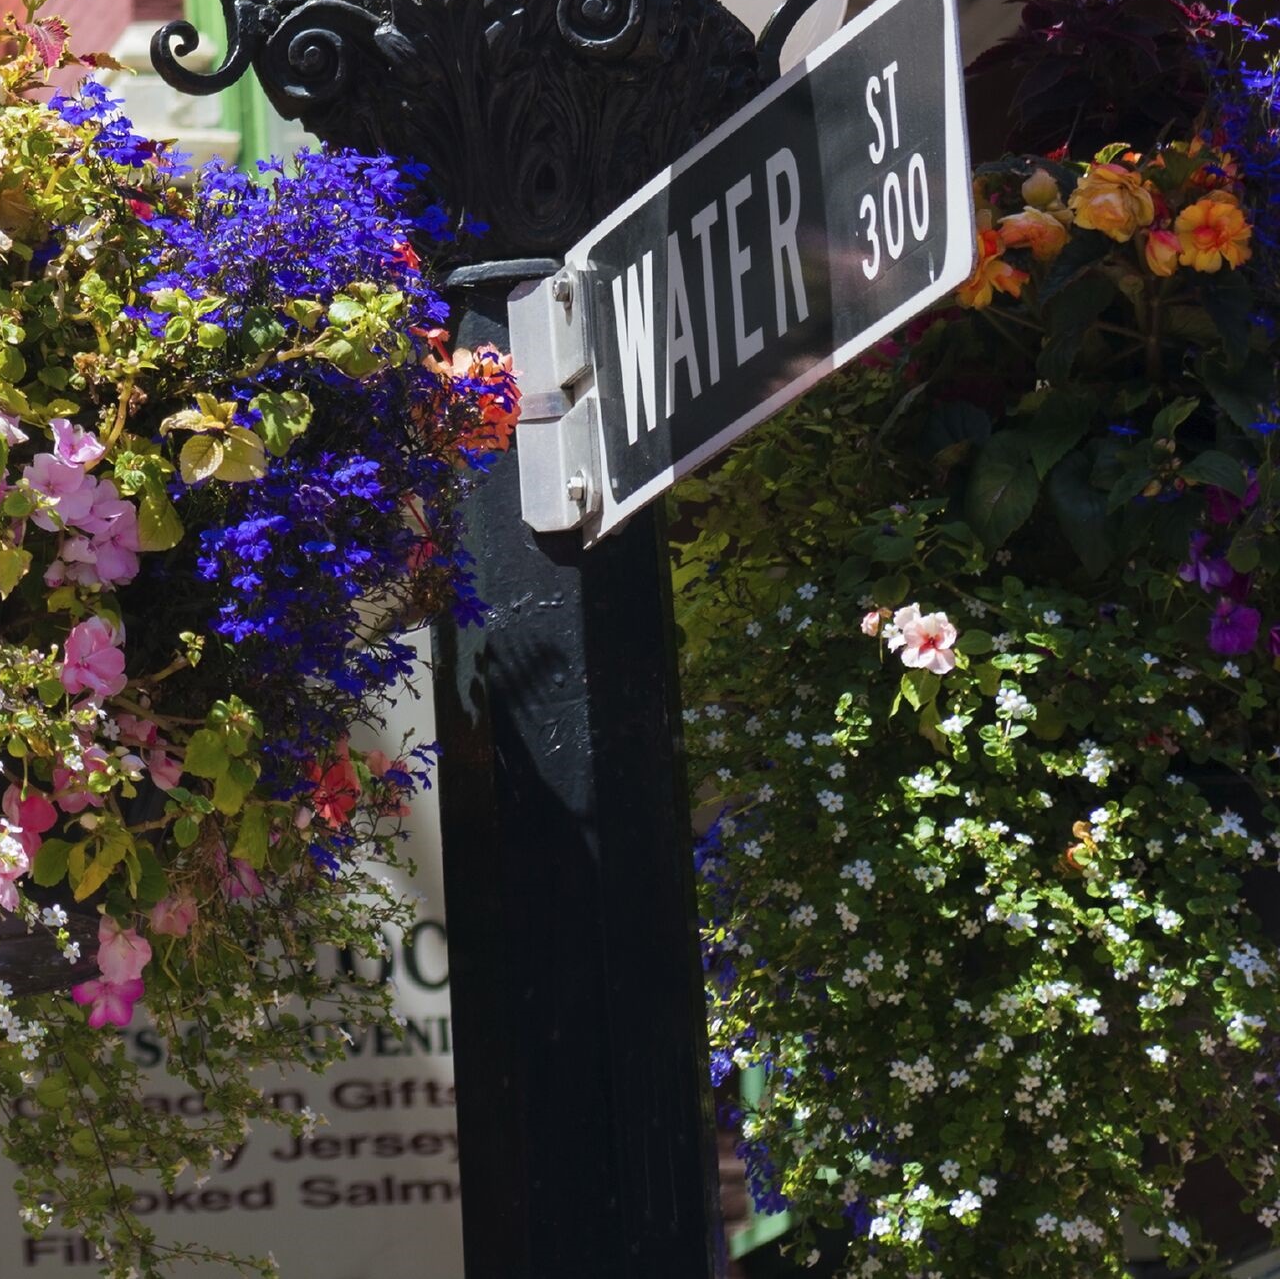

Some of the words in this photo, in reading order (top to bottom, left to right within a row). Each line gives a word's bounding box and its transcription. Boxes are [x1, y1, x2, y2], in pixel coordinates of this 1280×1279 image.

[865, 61, 904, 166] ST
[858, 152, 929, 282] 300
[612, 146, 809, 446] WATER
[298, 1171, 460, 1211] Salm
